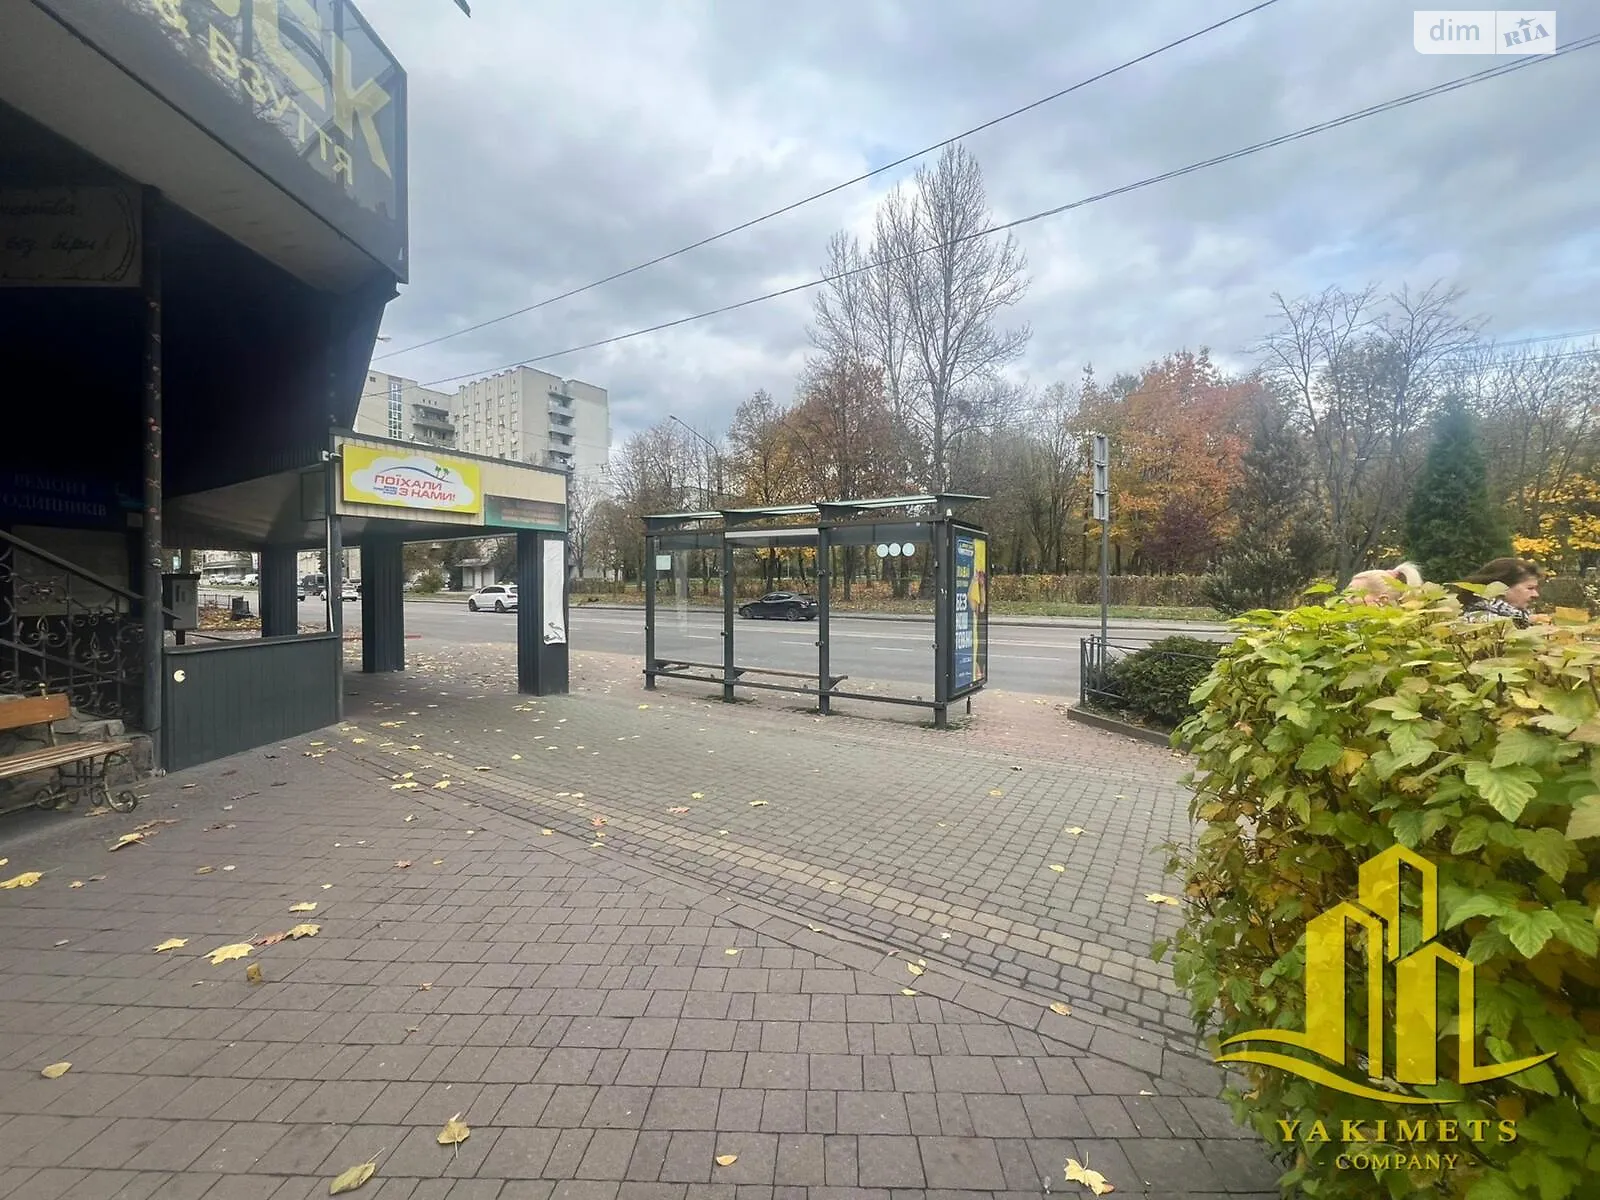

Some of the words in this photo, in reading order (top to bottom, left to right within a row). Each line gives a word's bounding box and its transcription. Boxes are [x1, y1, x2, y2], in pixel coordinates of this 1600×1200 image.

[207, 23, 353, 186] ВЗУТТЯ
[374, 474, 442, 491] ПОЇХАЛИ
[0, 491, 107, 516] ОДИННИКІВ
[398, 487, 409, 497] З
[411, 489, 456, 502] НАМИ!
